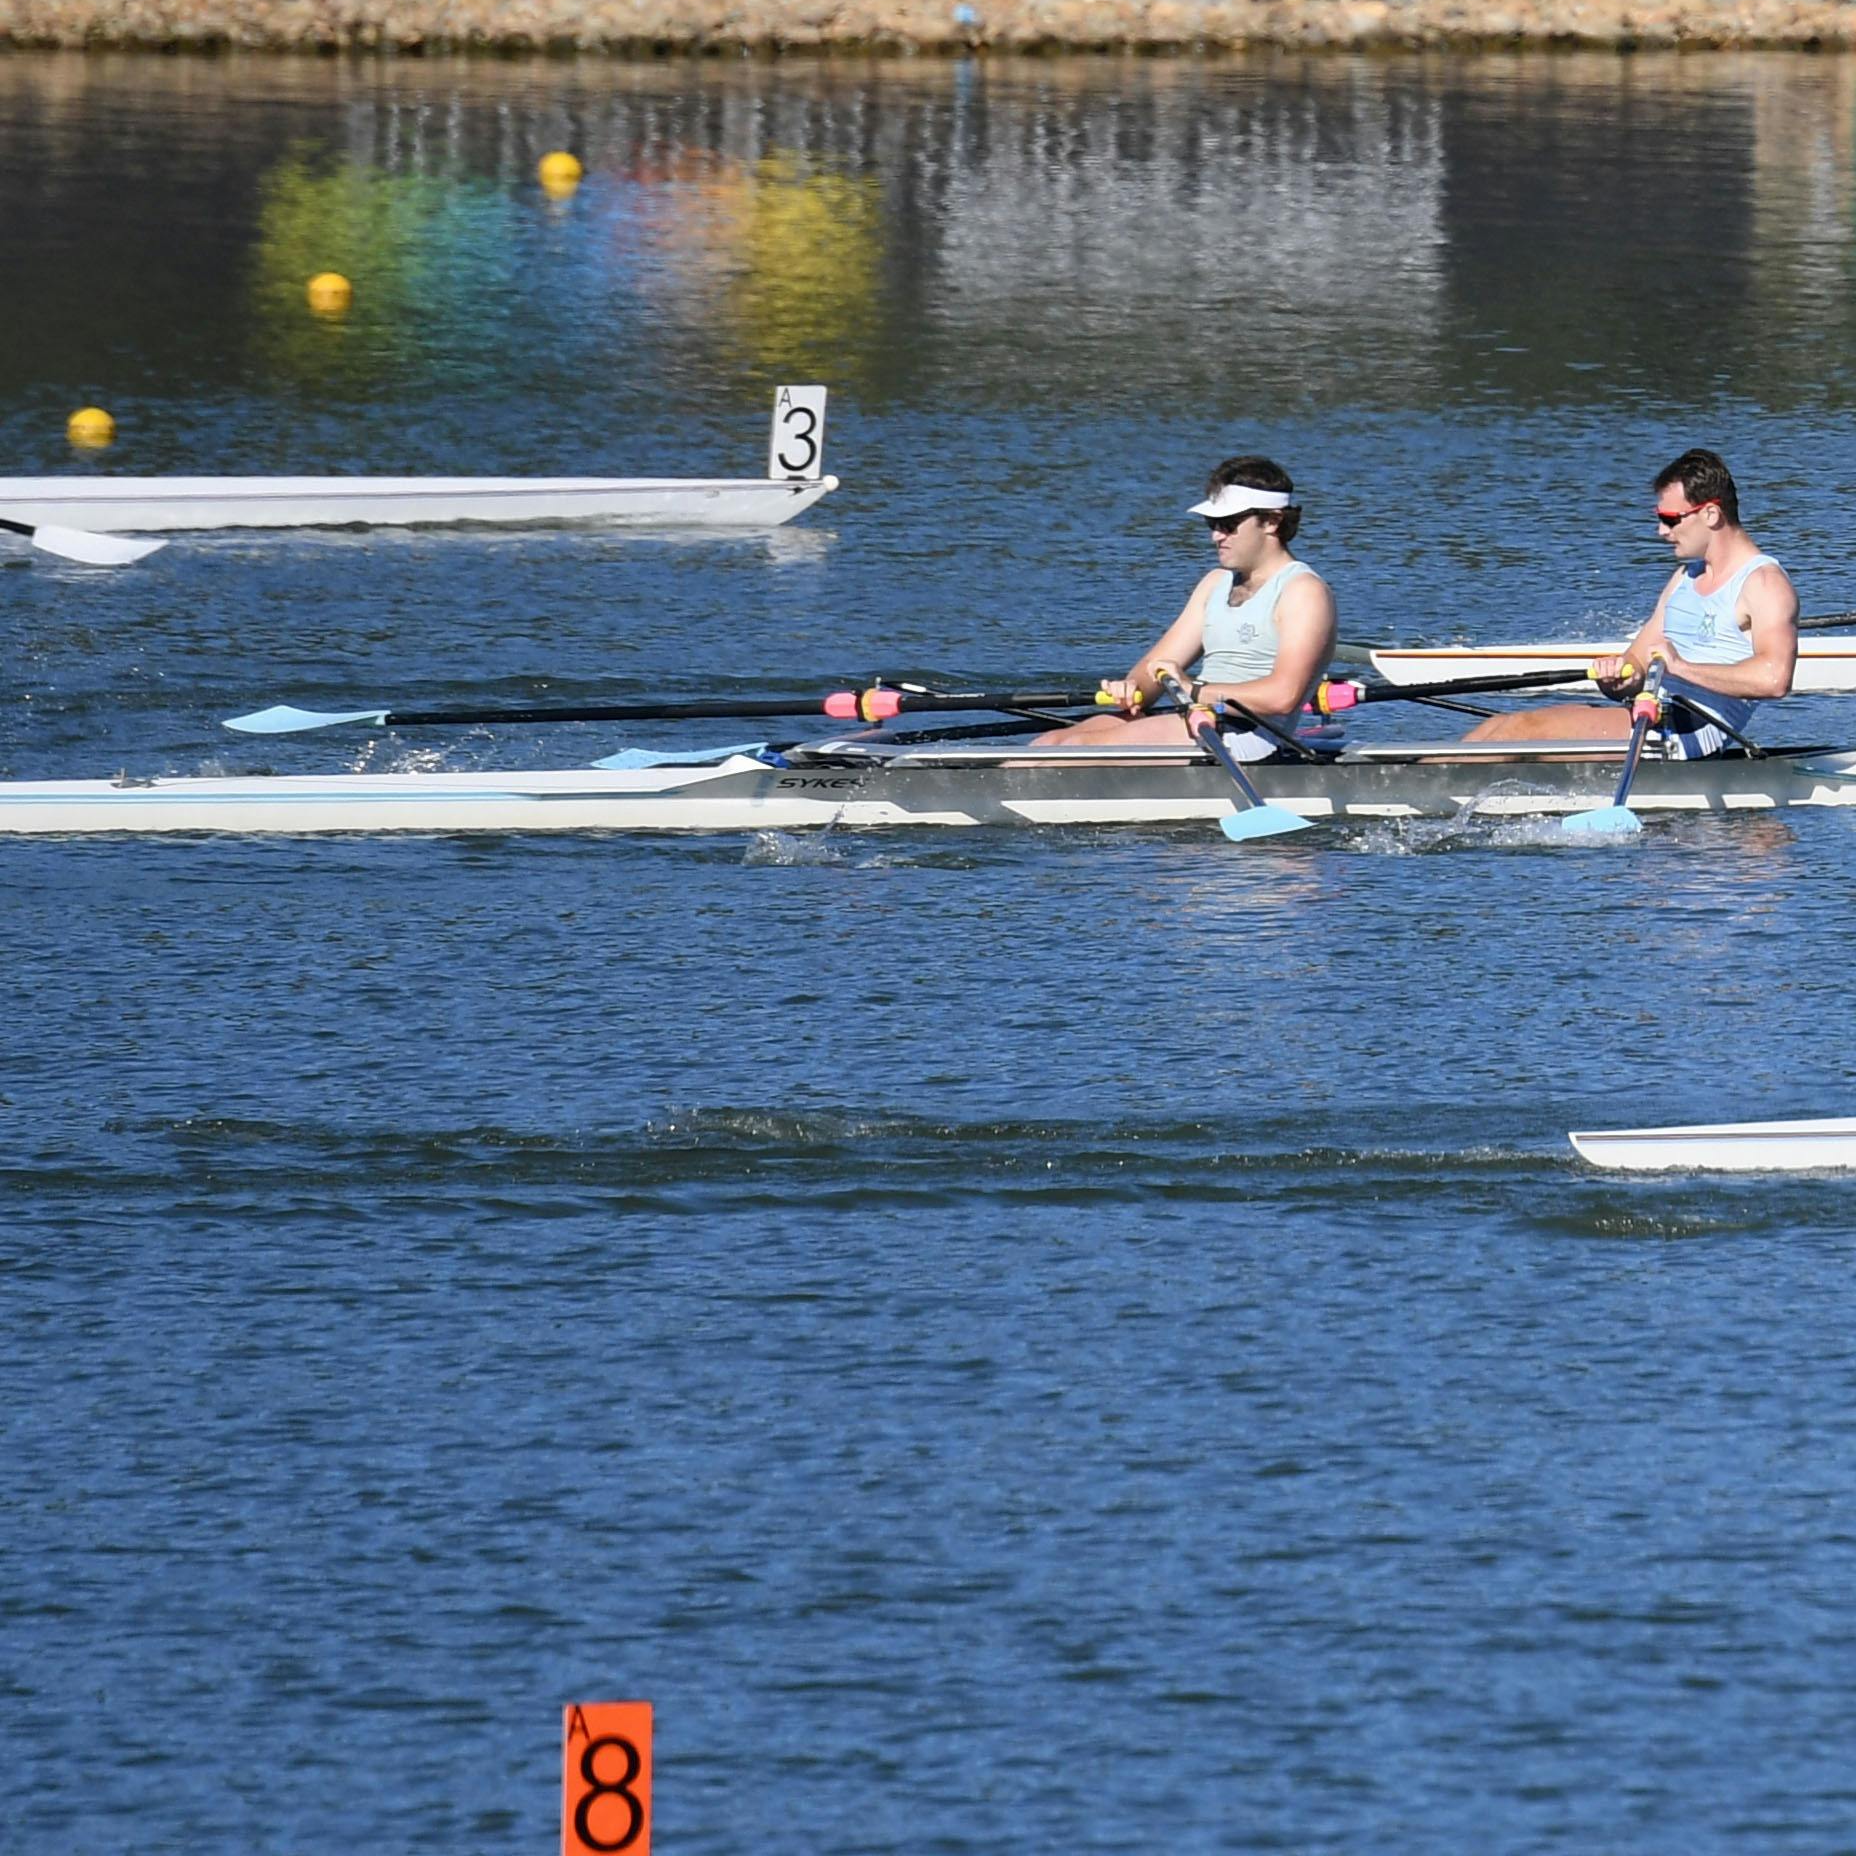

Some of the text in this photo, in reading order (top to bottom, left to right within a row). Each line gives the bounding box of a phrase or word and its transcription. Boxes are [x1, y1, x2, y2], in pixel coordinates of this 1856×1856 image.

[778, 387, 793, 407] A
[777, 406, 818, 472] 3
[568, 1705, 591, 1746] A
[574, 1735, 645, 1853] 8
